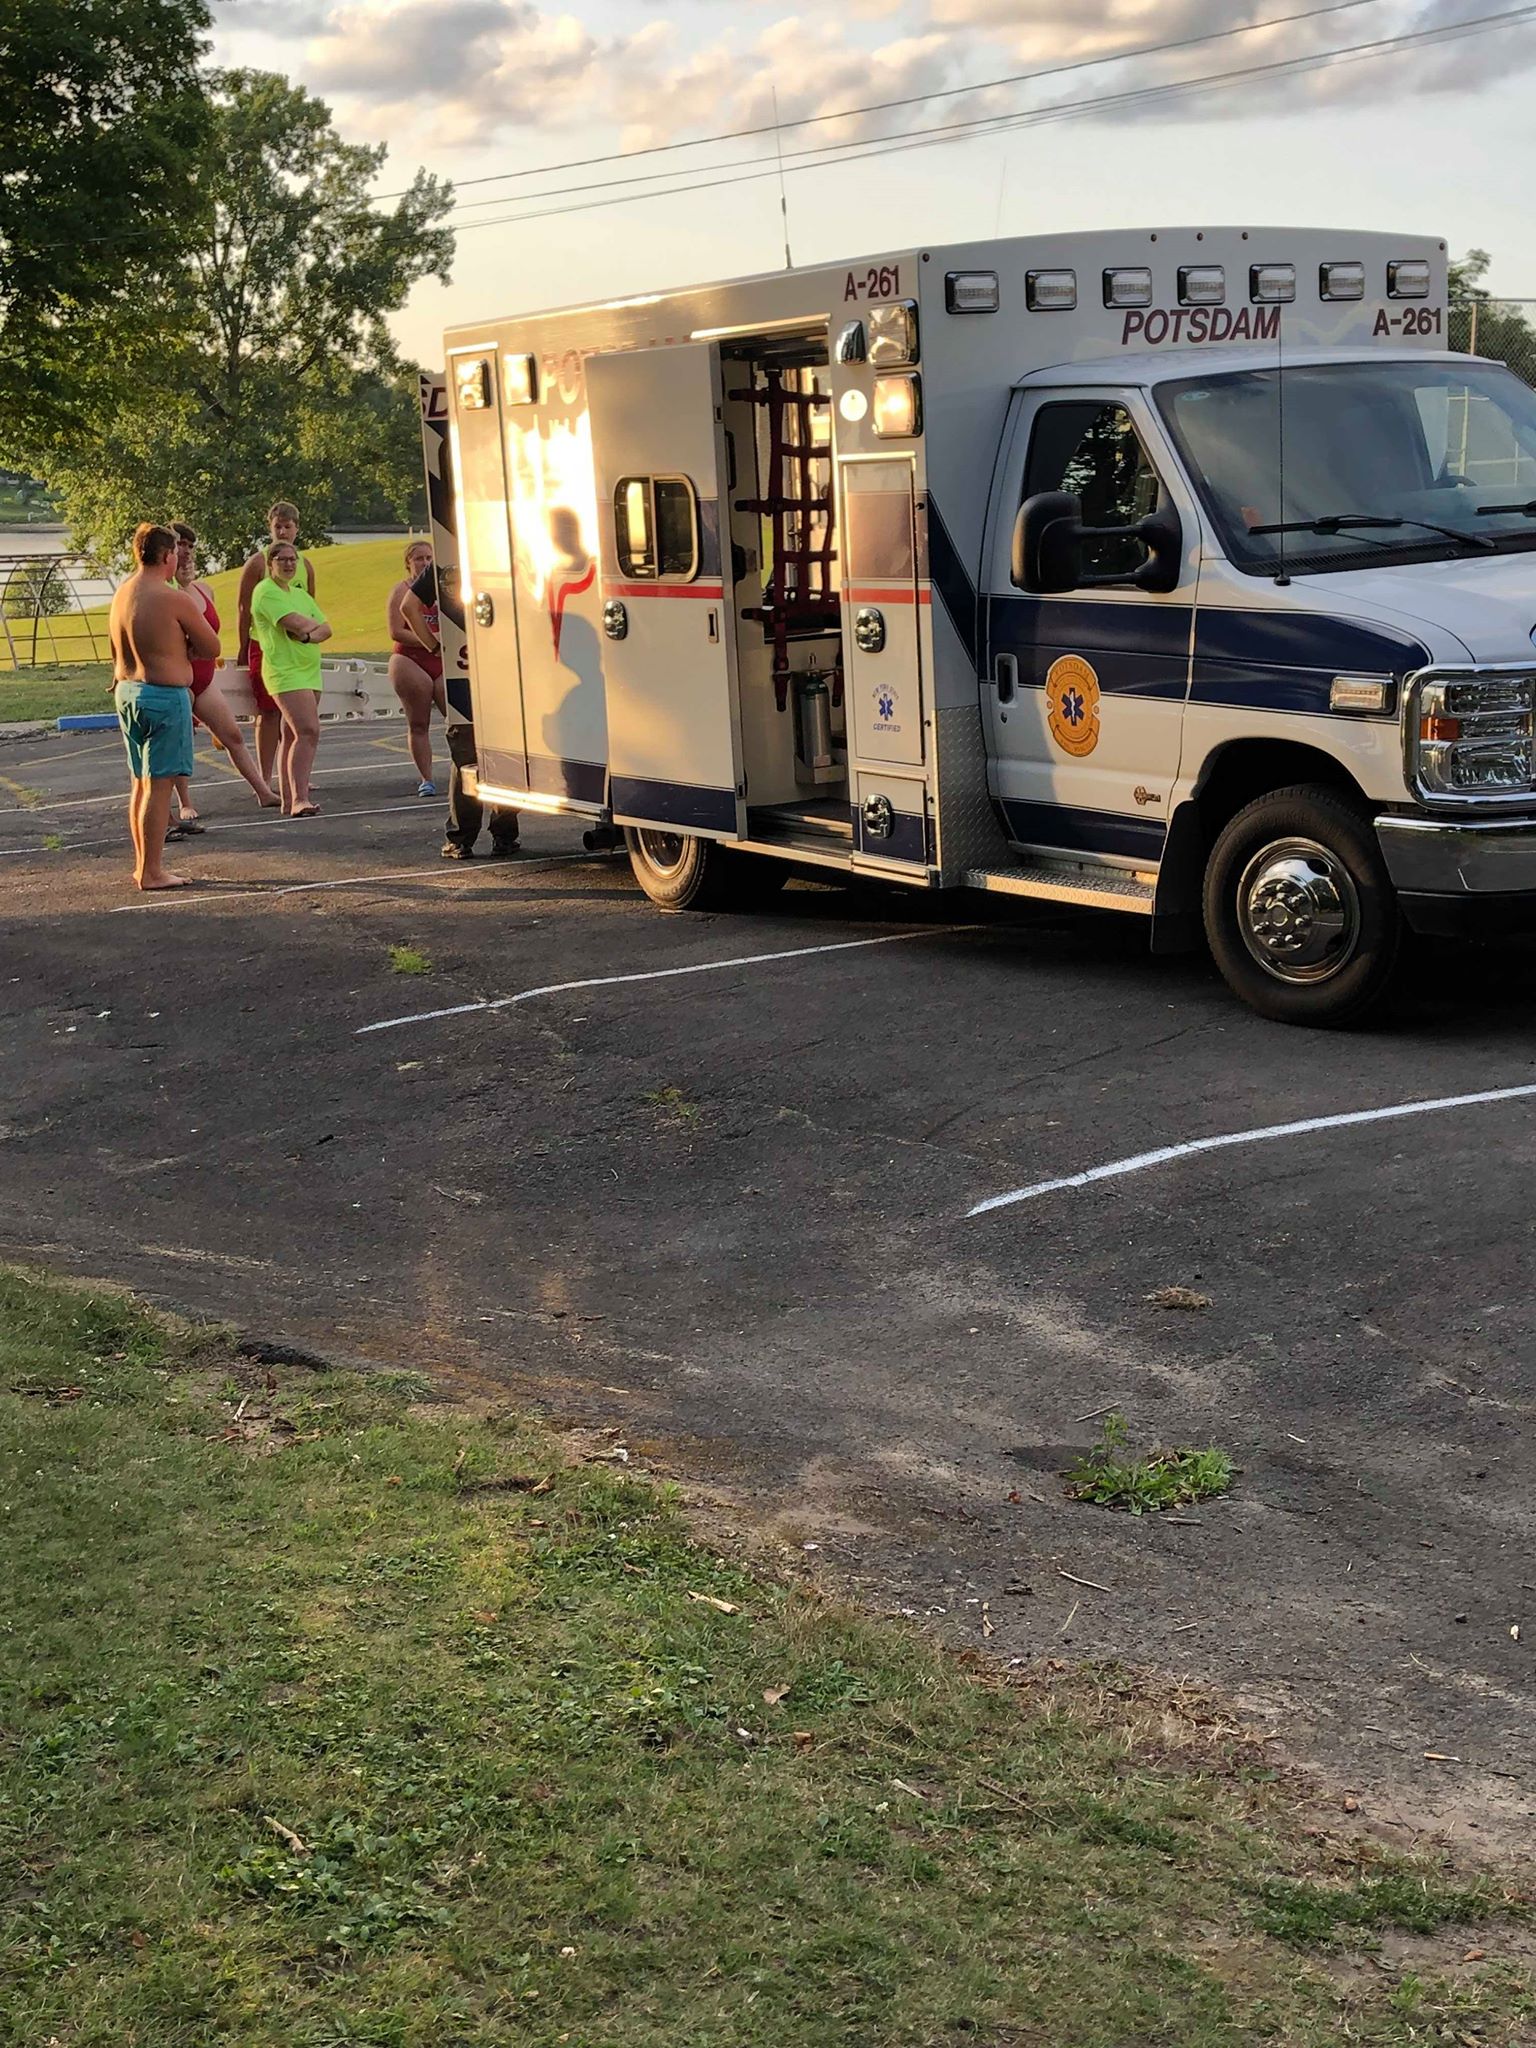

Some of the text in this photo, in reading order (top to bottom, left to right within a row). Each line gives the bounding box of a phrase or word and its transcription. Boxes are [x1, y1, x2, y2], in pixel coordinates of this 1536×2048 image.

[844, 265, 899, 302] A-261
[1122, 306, 1281, 345] POTSDAM
[1373, 307, 1442, 336] A-261
